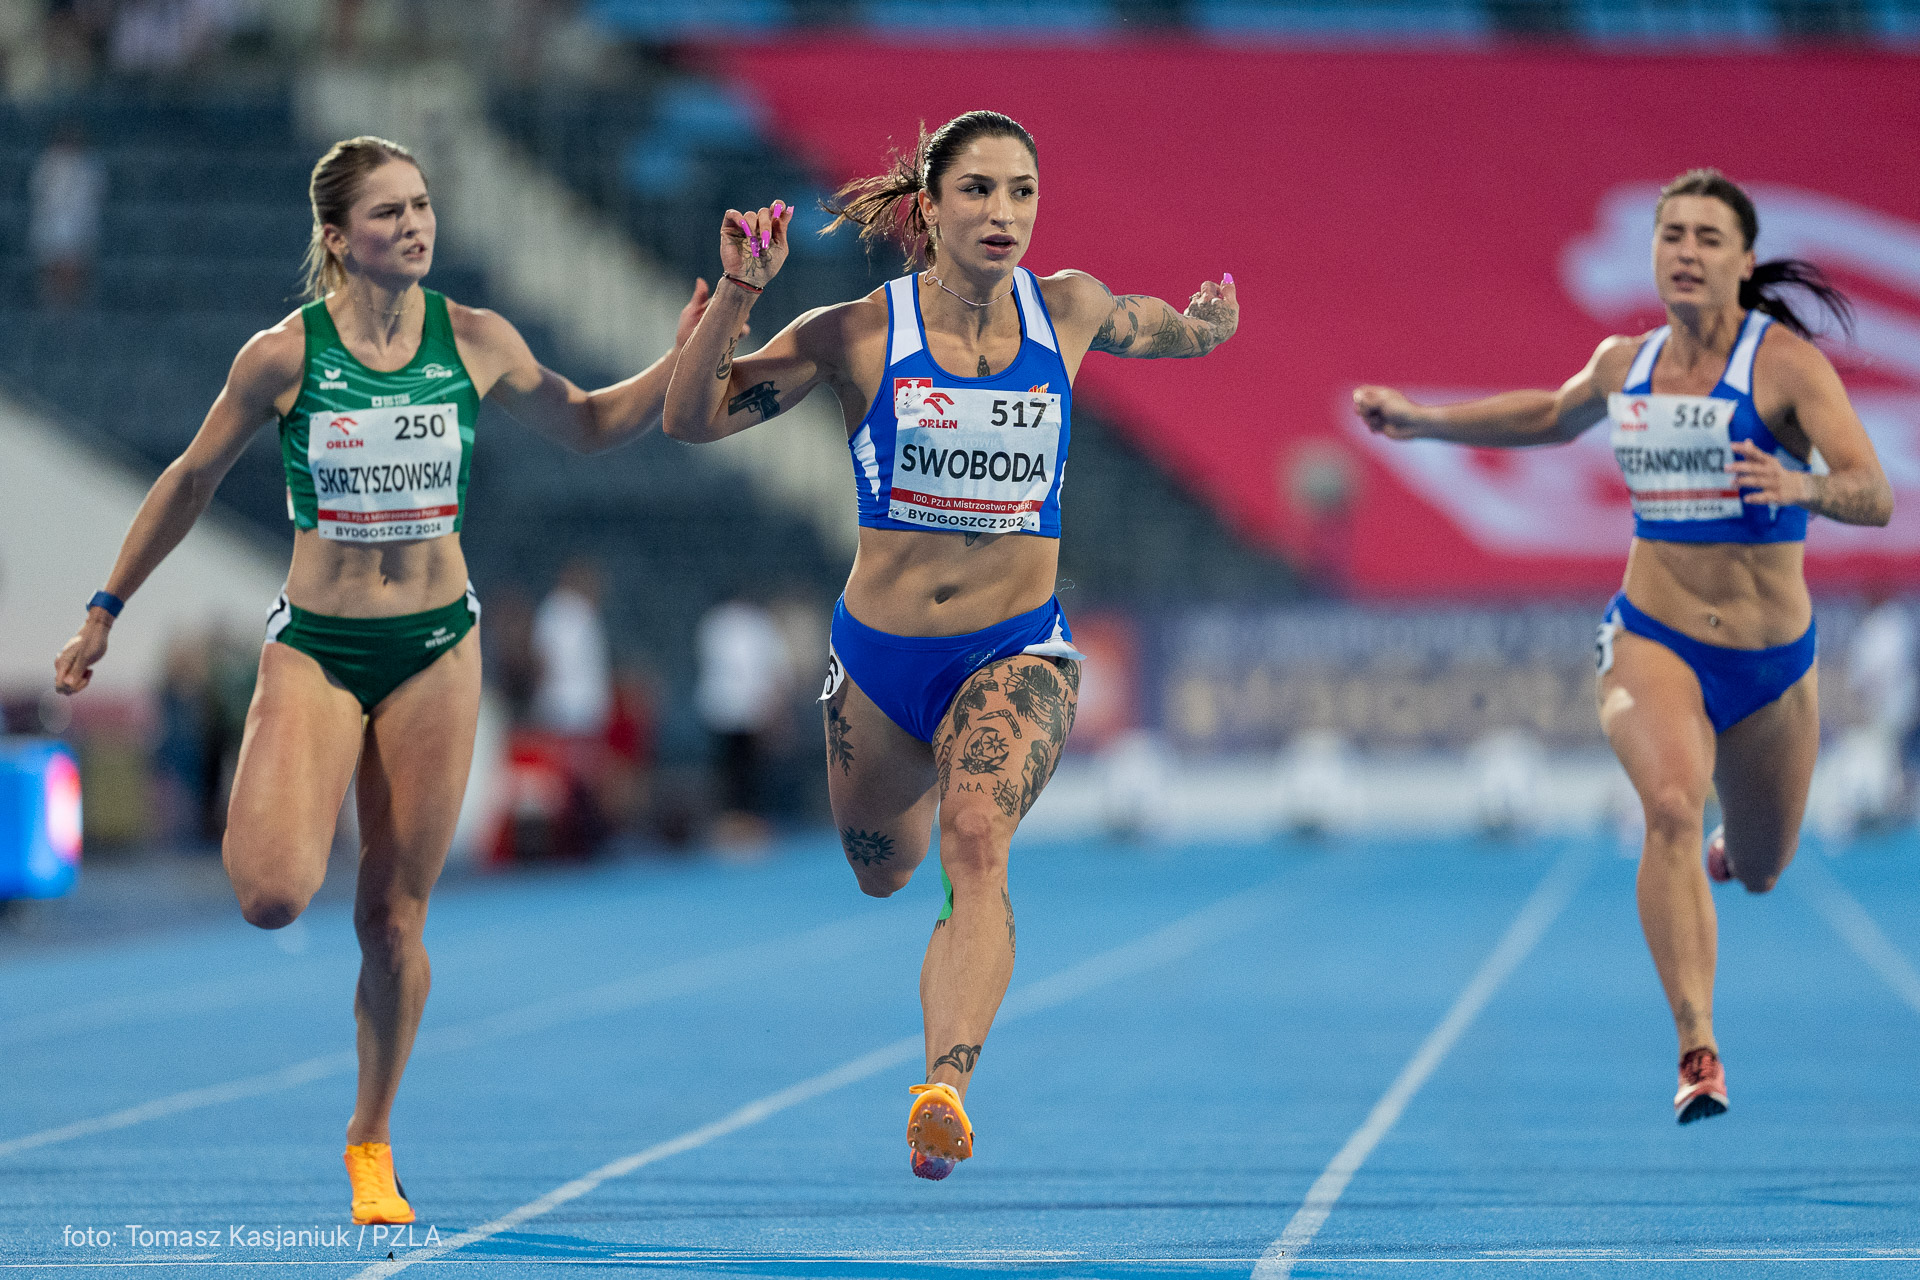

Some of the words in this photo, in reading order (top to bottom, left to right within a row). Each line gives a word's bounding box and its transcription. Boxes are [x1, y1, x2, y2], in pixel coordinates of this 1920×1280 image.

[918, 418, 958, 430] ORLEN
[990, 400, 1047, 428] 517
[1673, 403, 1716, 428] 516
[395, 414, 446, 441] 250
[326, 439, 364, 449] ORLEN
[900, 443, 1048, 483] SWOBODA
[318, 461, 452, 495] SKRZYSZOWSKA
[913, 493, 929, 504] 100.
[931, 497, 951, 508] PZLA
[953, 499, 1006, 511] Mistrzostwa
[1007, 502, 1033, 512] Polski
[908, 508, 997, 529] BYDGOSZCZ
[1000, 516, 1025, 530] 202
[335, 525, 415, 538] BYDGOSZCZ
